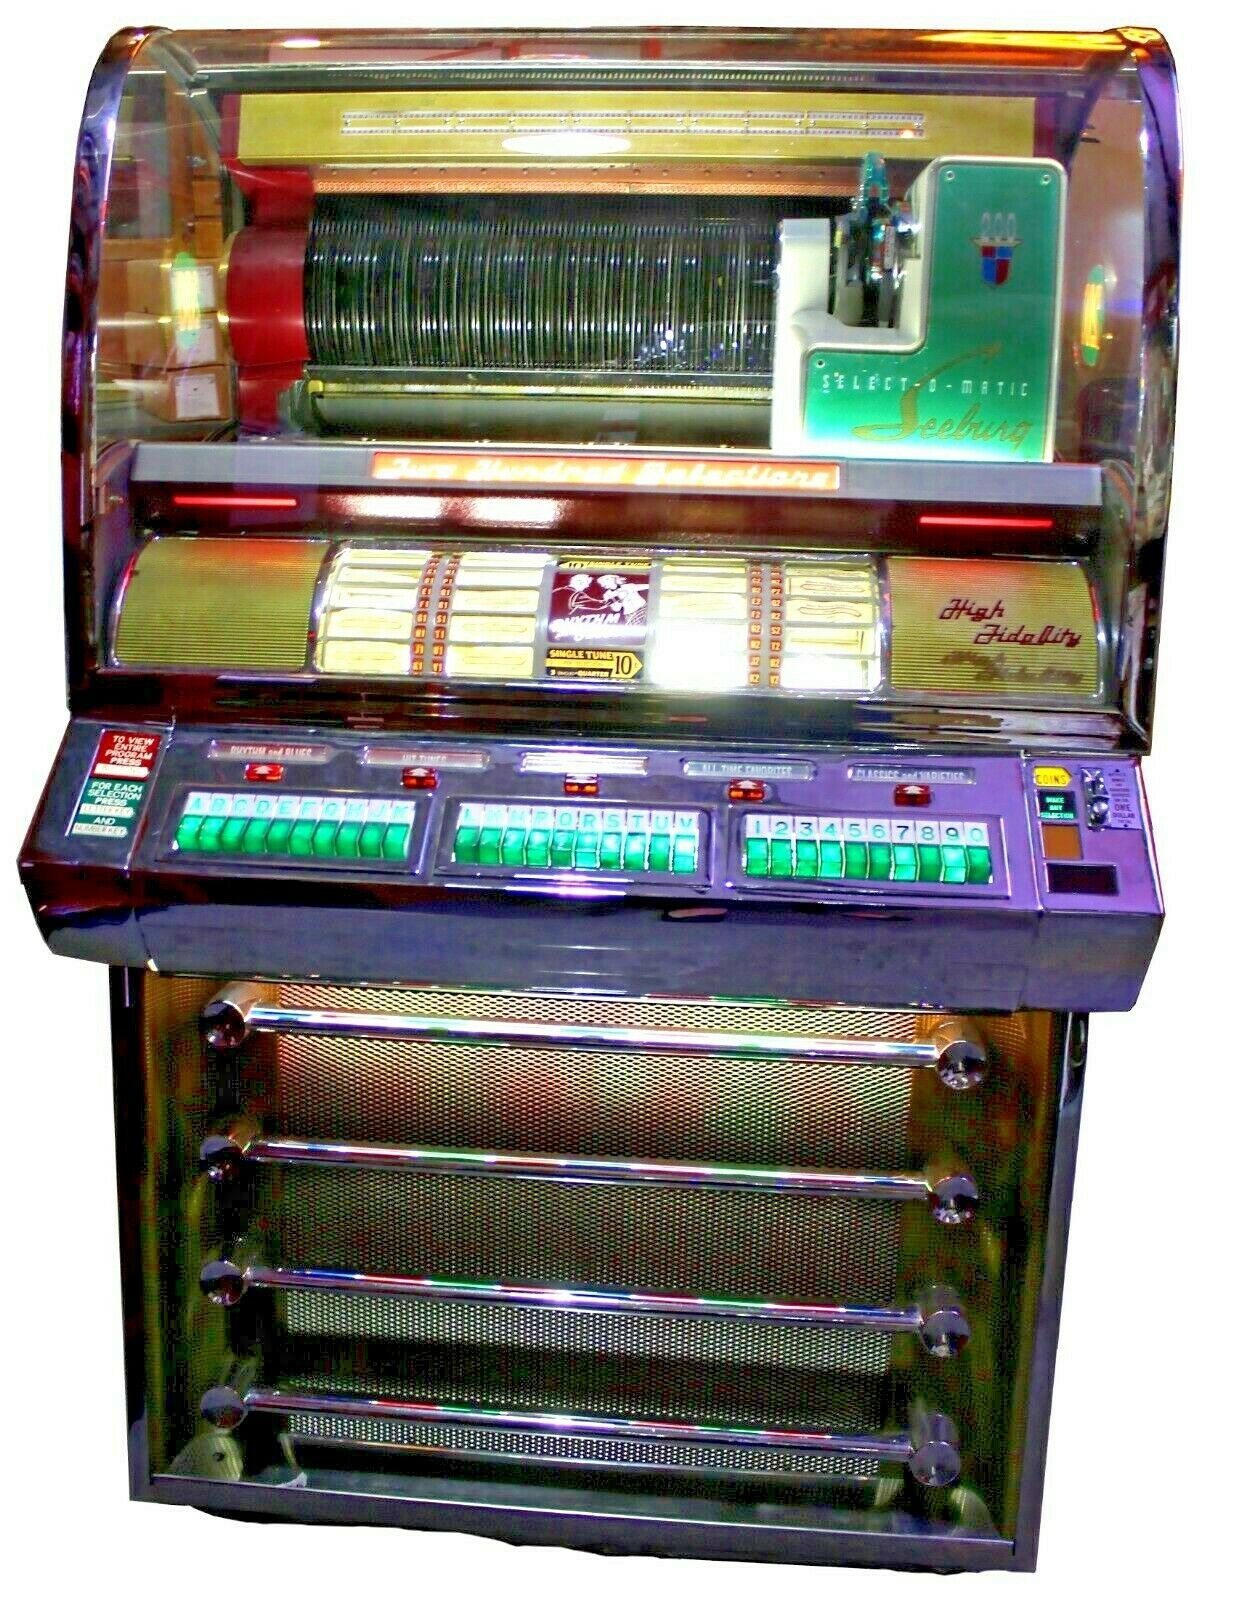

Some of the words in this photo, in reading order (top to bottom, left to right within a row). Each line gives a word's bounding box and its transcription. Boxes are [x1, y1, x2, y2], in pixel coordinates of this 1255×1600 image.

[822, 374, 1029, 397] SELECT-O-MATIC
[852, 342, 1032, 451] Seeburg
[465, 458, 628, 485] Hundred
[634, 461, 831, 490] Selections
[938, 599, 1005, 622] High
[973, 624, 1082, 648] Fidelity
[549, 650, 584, 659] SINGLE
[586, 651, 613, 660] TUNE
[615, 655, 633, 675] 10
[112, 735, 125, 743] TO
[128, 736, 155, 746] VIEW
[114, 743, 148, 753] ENTIRE
[105, 750, 153, 760] PROGRAM
[109, 757, 142, 767] PRESS
[1036, 774, 1068, 785] COINS
[91, 781, 112, 791] FOR
[114, 782, 143, 792] EACH
[87, 788, 142, 801] SELECTION
[94, 797, 128, 807] PRESS
[93, 816, 116, 825] AND
[583, 814, 597, 828] R
[607, 814, 620, 828] S
[631, 815, 644, 829] T
[655, 816, 669, 830] U
[680, 817, 693, 829] V
[755, 820, 761, 834] 1
[775, 821, 789, 835] 2
[800, 822, 813, 836] 3
[822, 822, 836, 836] 4
[849, 823, 862, 837] 5
[872, 824, 886, 838] 6
[896, 825, 910, 838] 7
[921, 826, 935, 840] 8
[945, 827, 959, 841] 9
